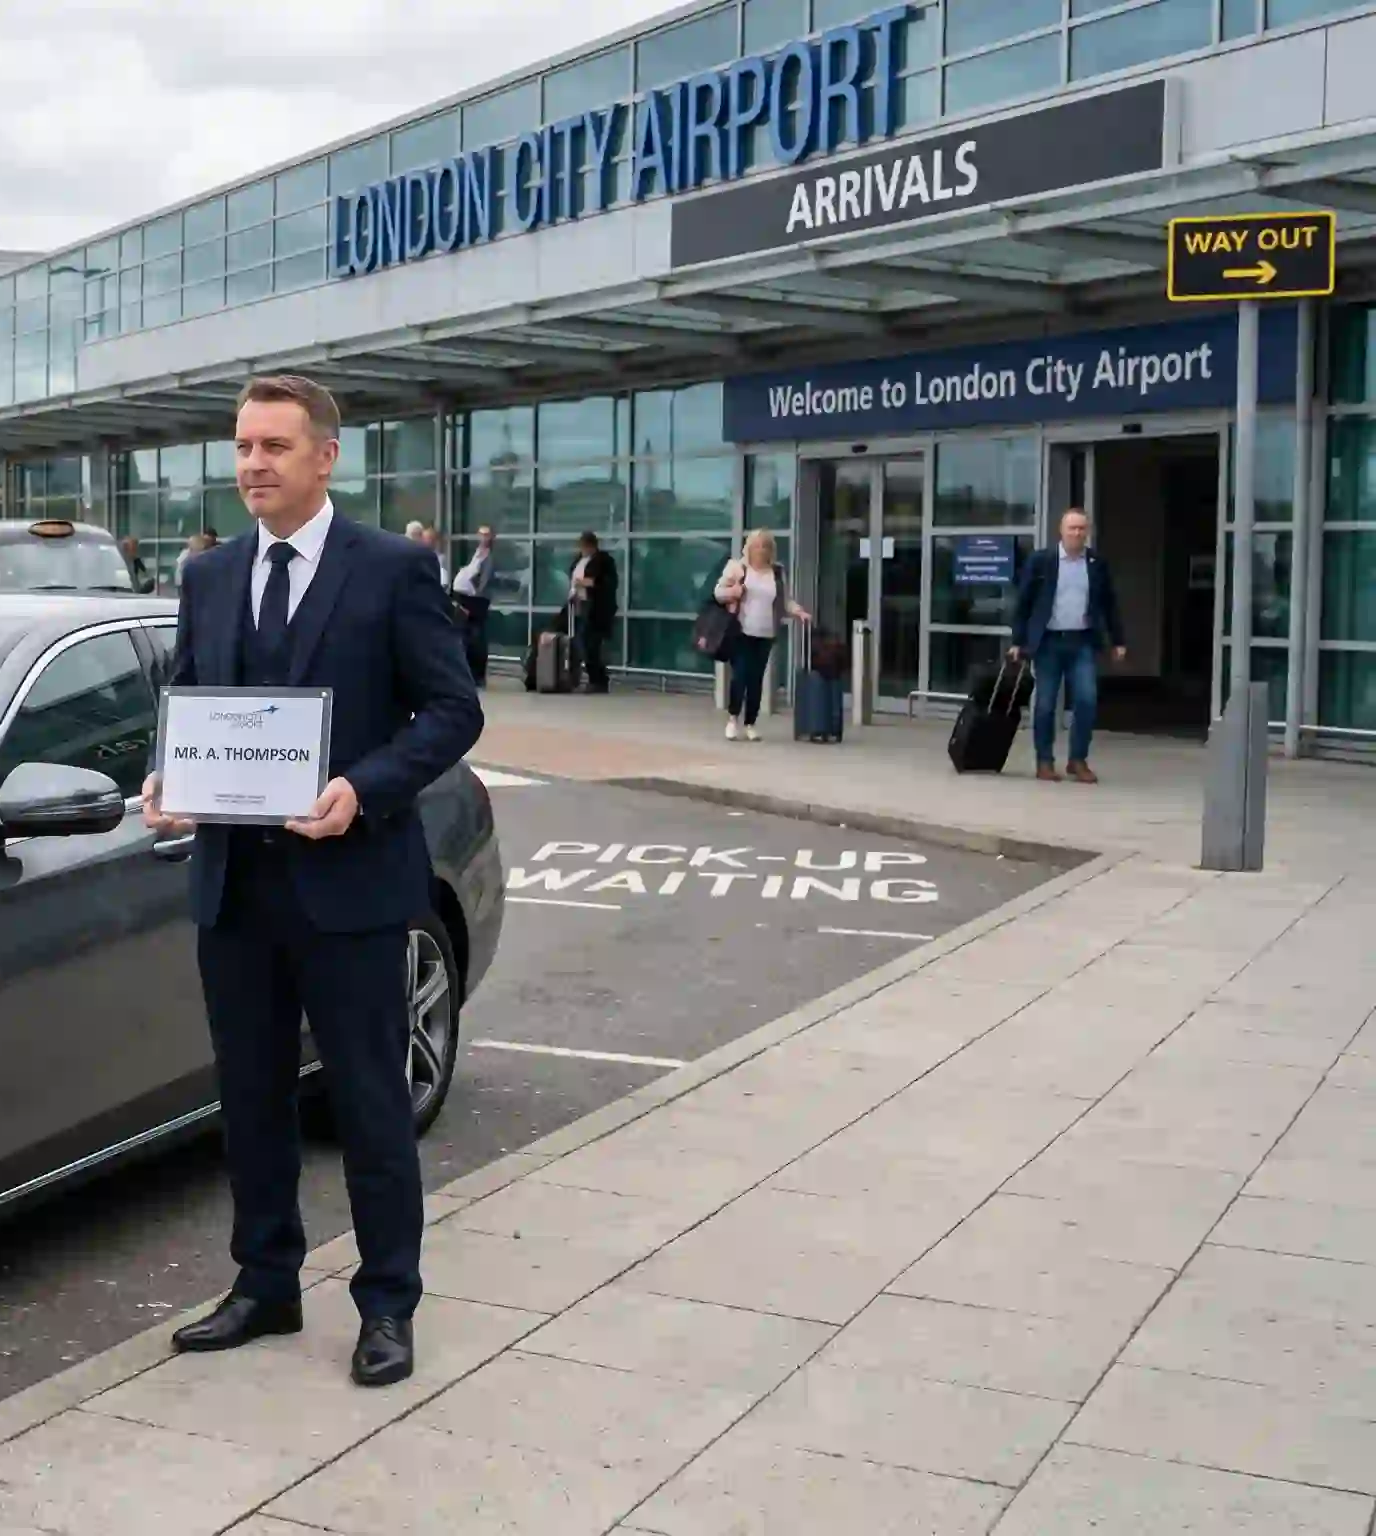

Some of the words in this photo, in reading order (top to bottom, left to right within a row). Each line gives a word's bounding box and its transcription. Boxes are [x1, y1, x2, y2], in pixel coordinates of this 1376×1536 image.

[328, 146, 496, 277] LONDON
[504, 104, 623, 231] CITY
[630, 4, 911, 201] AIRPORT
[785, 141, 978, 234] ARRIVALS
[1184, 229, 1249, 255] WAY
[1257, 225, 1319, 250] OUT
[769, 380, 873, 418] Welcome
[880, 377, 906, 408] to
[915, 363, 1016, 406] London
[1026, 355, 1084, 402] City
[1092, 342, 1213, 395] Airport
[174, 746, 202, 761] MR.
[206, 747, 220, 761] A.
[224, 747, 310, 762] THOMPSON
[530, 842, 928, 872] PICK-UP
[506, 867, 939, 903] WAITING
